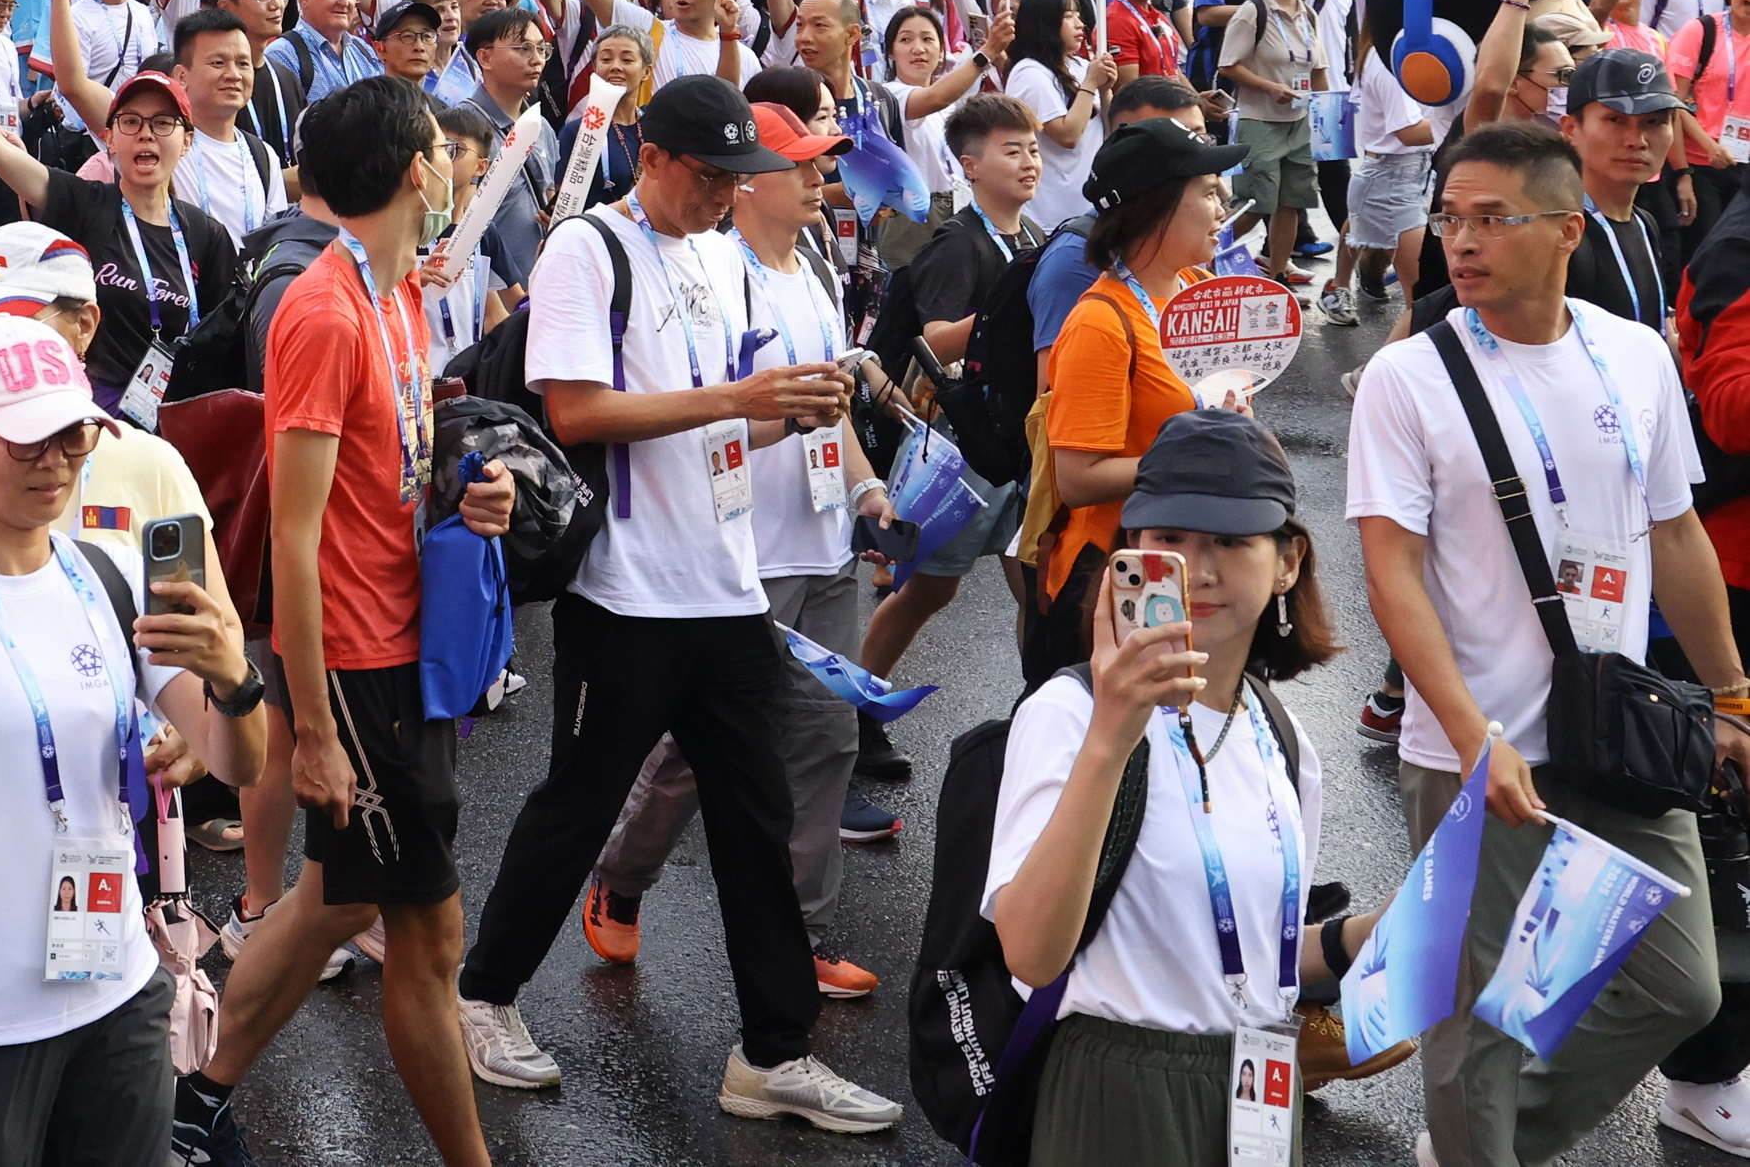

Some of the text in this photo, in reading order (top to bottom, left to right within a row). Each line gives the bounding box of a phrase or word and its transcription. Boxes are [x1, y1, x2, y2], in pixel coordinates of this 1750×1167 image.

[95, 262, 139, 292] Run
[1166, 307, 1238, 337] KANSAI!
[98, 878, 112, 892] A.
[1422, 859, 1434, 901] GAMES
[945, 990, 965, 1044] BEYOND
[960, 1002, 985, 1062] WITHOUT
[961, 1043, 986, 1097] SPORTS
[979, 1061, 995, 1092] IFE
